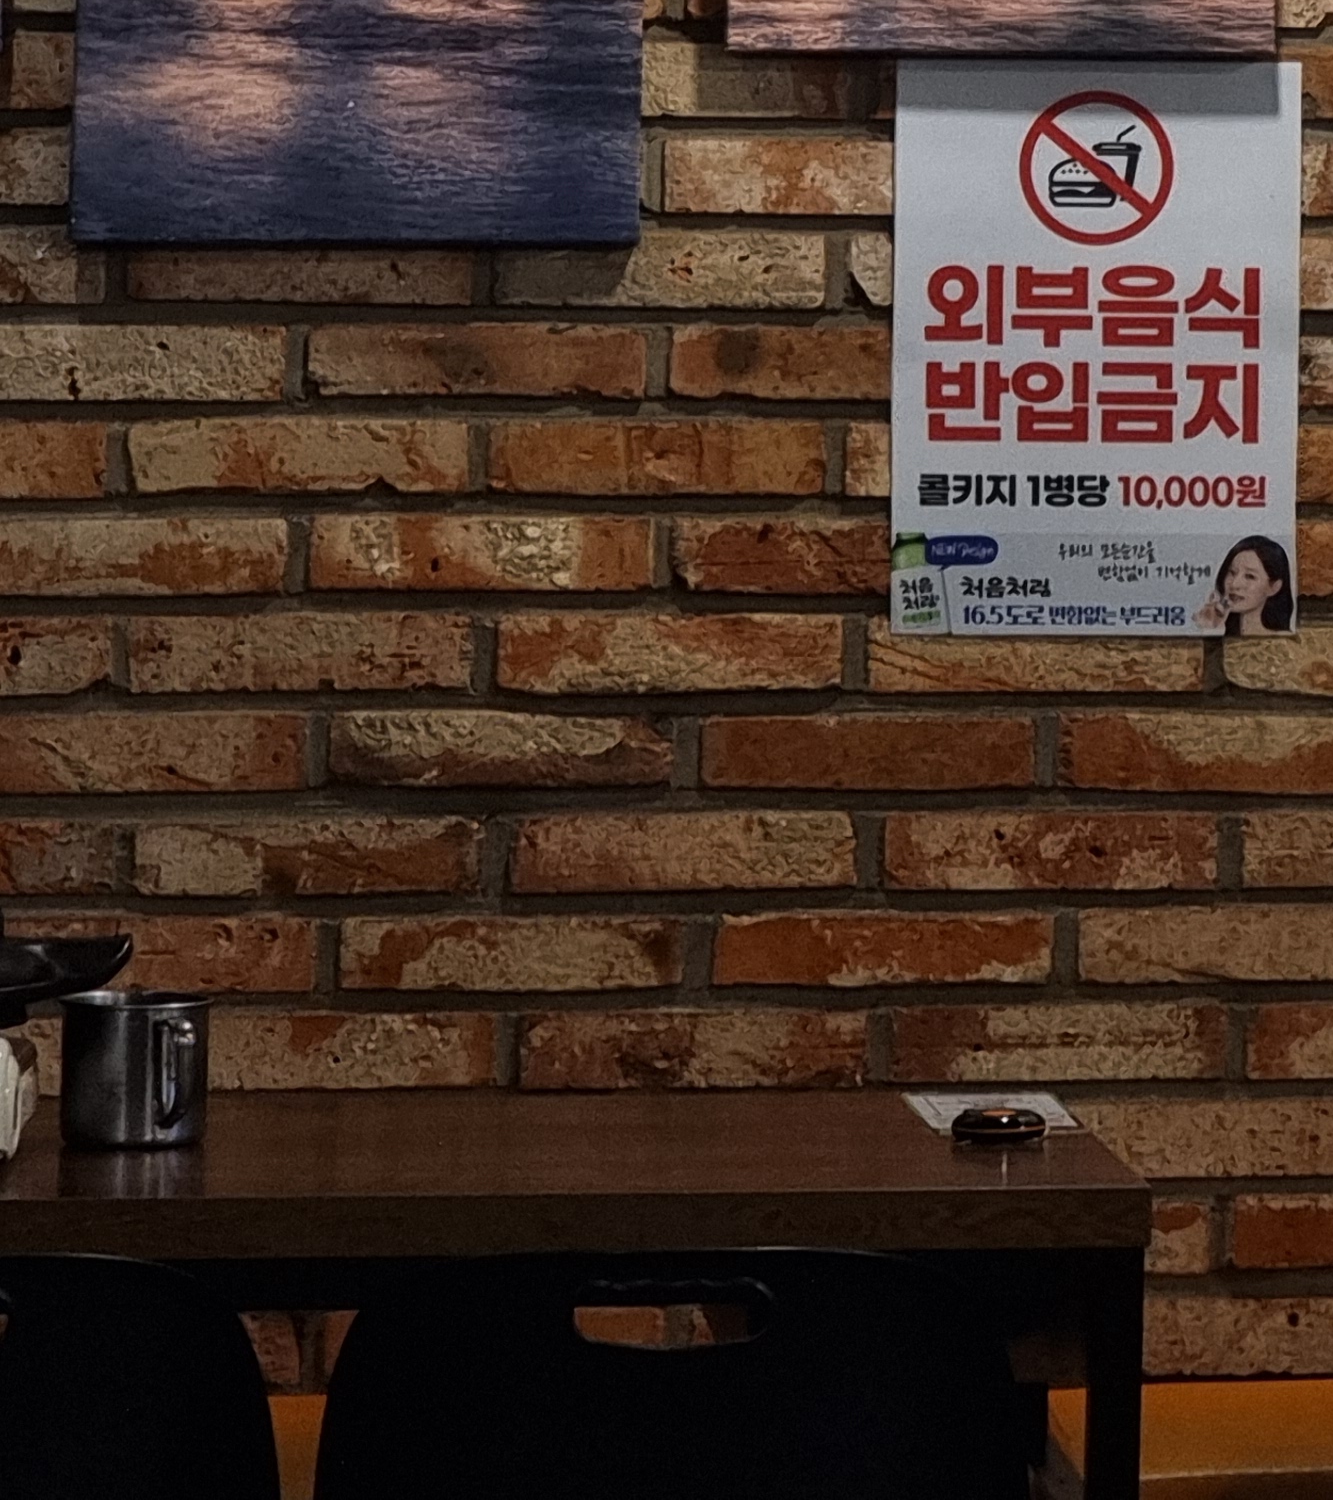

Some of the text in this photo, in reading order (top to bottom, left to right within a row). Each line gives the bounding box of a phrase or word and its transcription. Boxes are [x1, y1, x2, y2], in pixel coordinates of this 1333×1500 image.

[924, 265, 1261, 349] 외부음식
[925, 361, 1260, 444] 반입금지
[918, 474, 1267, 510] 콜키지 1병당 10,000원
[960, 576, 1052, 598] 처음처럼
[1119, 604, 1186, 627] 부드러움
